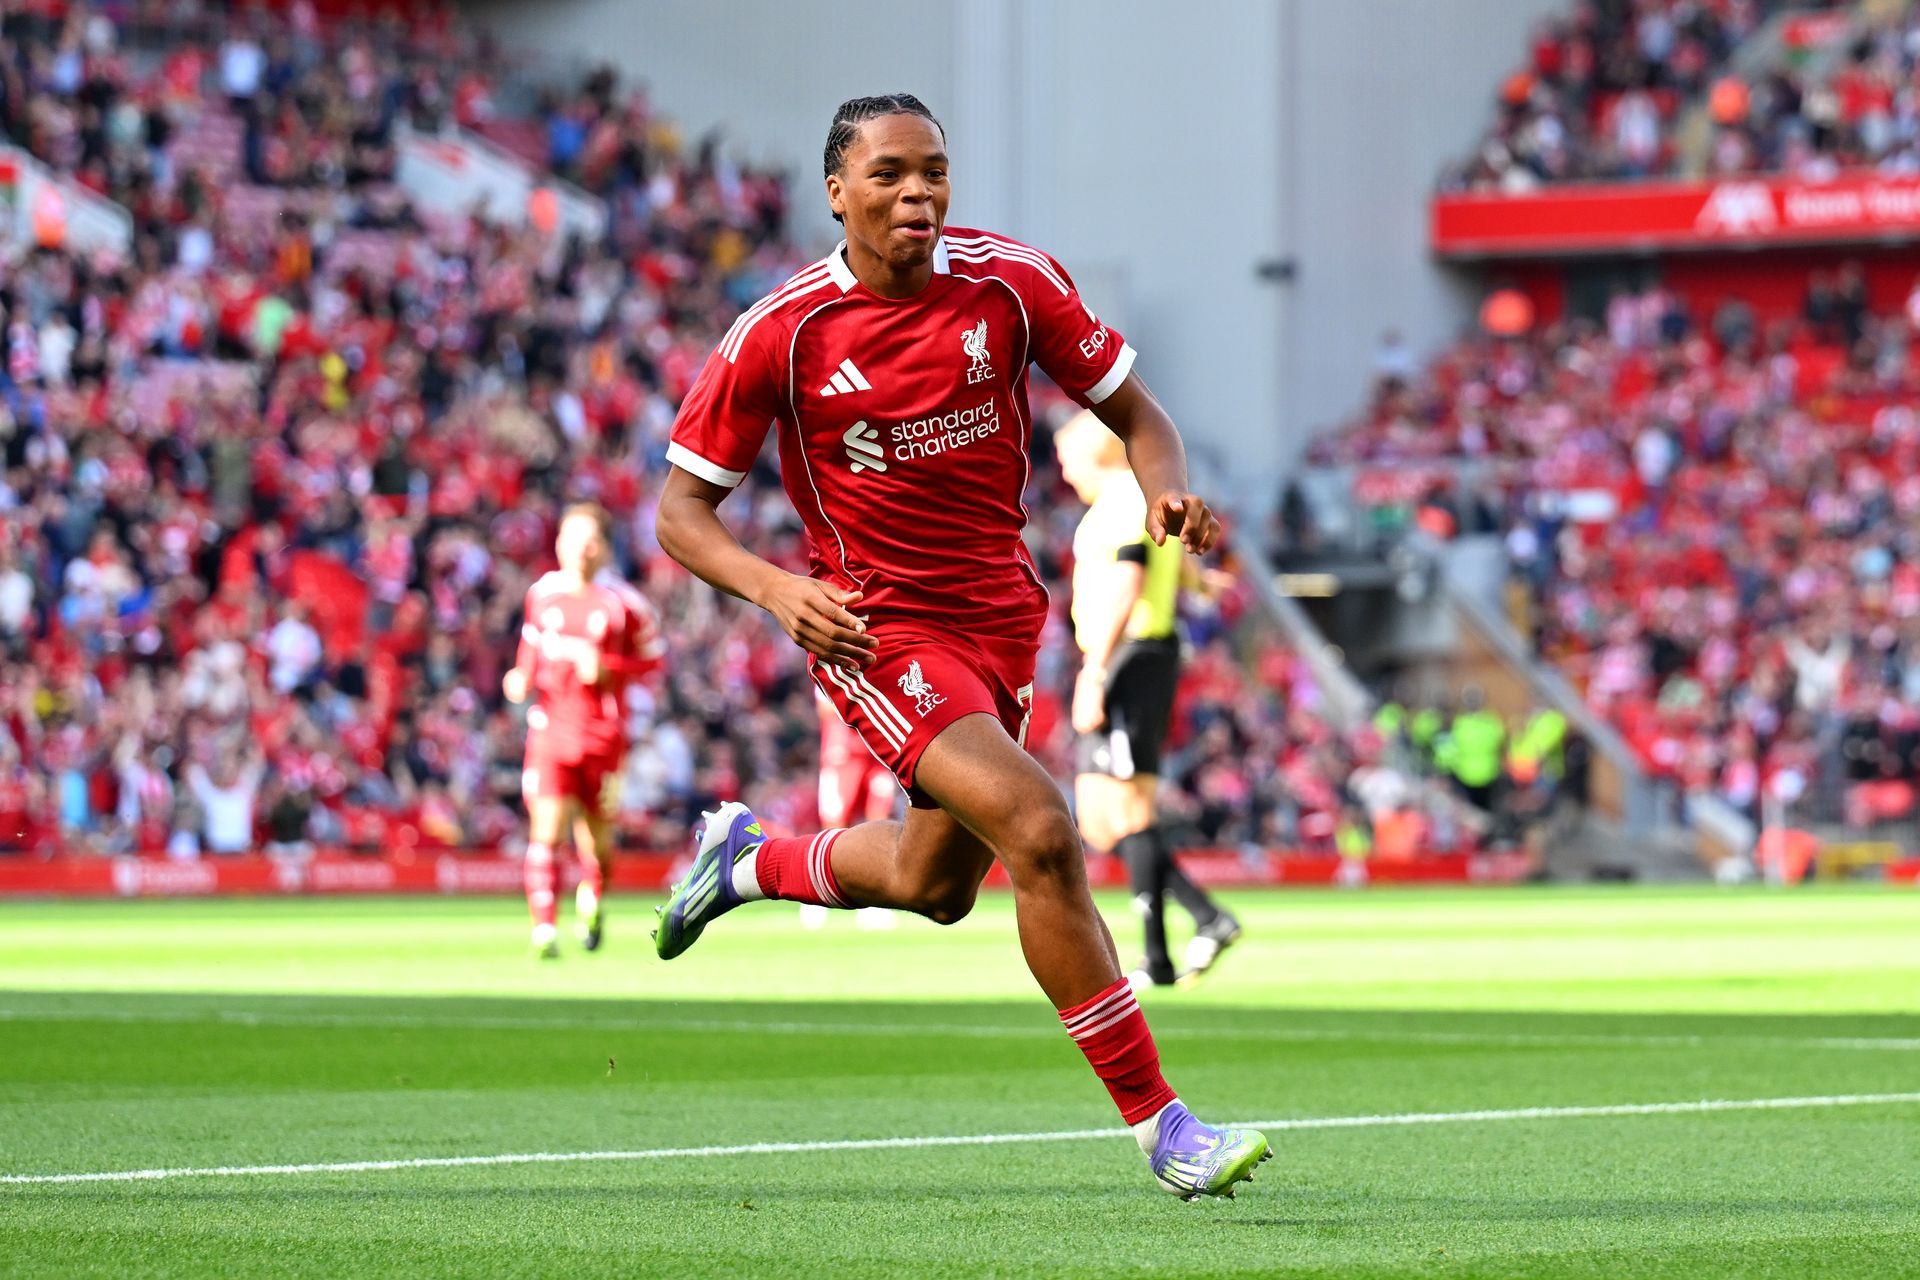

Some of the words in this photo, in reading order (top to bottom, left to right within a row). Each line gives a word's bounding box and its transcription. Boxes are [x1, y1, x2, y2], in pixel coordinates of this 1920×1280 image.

[967, 367, 996, 385] L.F.C.
[891, 397, 994, 441] standard
[895, 413, 1000, 461] chartered
